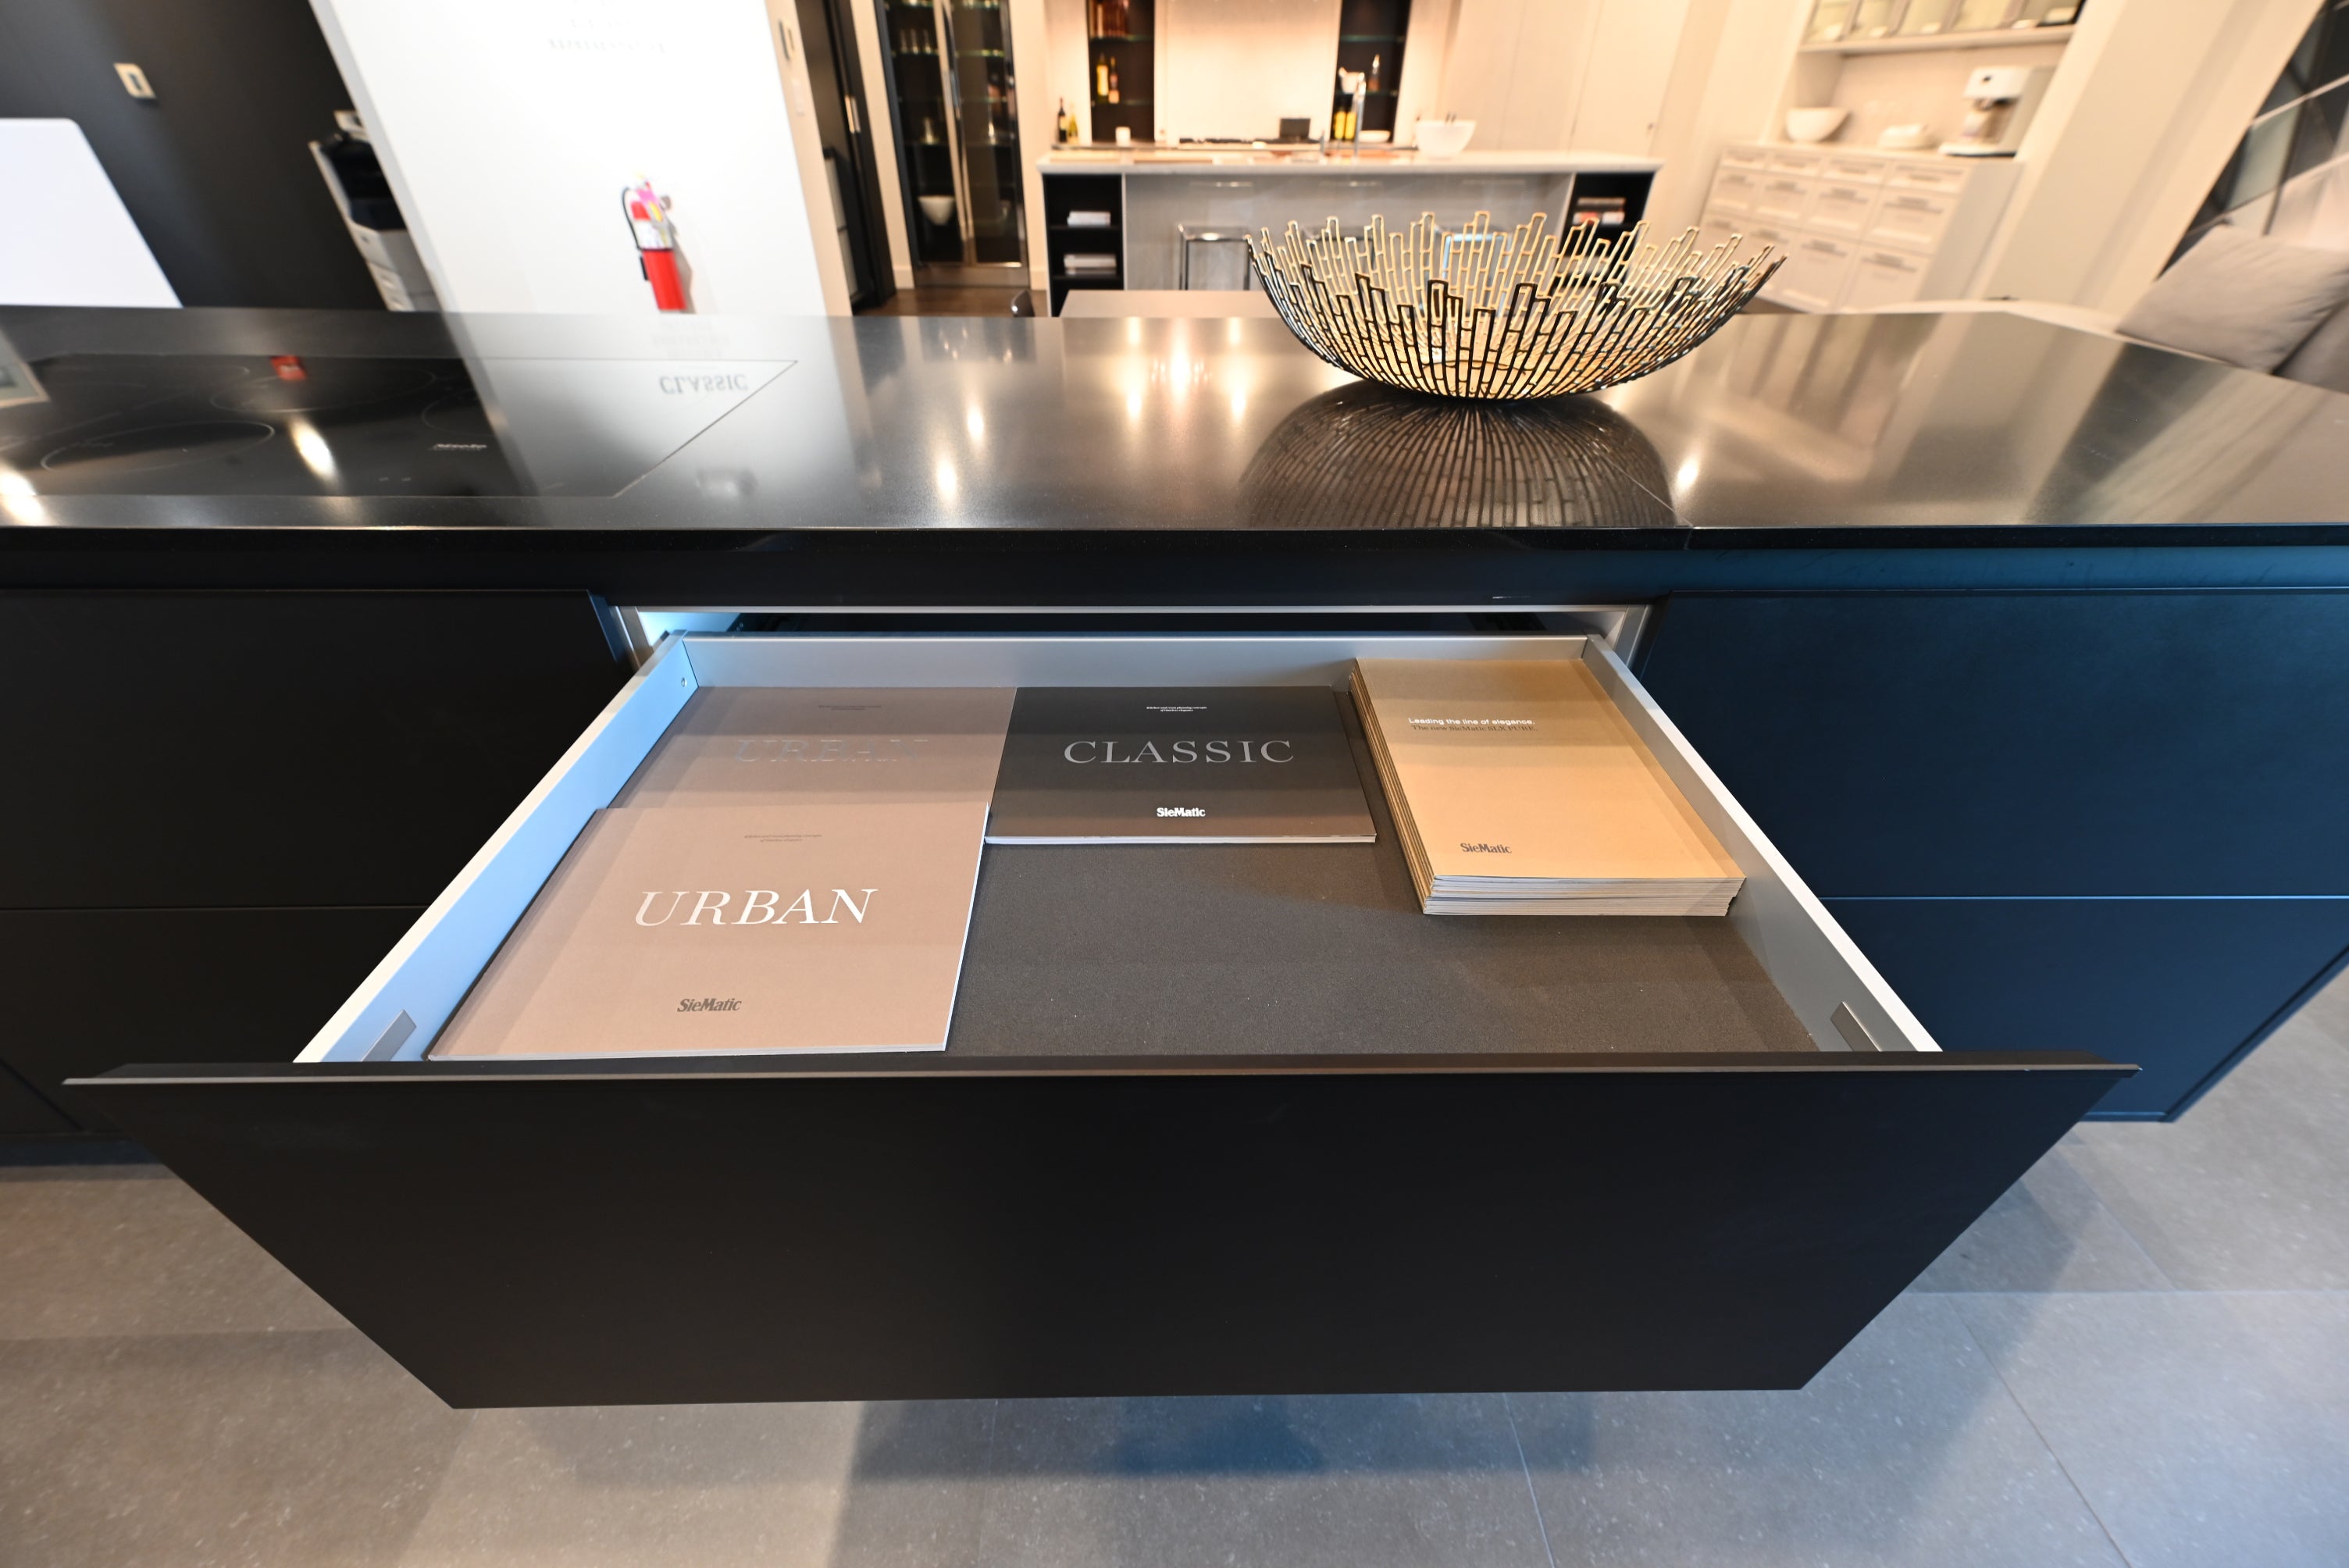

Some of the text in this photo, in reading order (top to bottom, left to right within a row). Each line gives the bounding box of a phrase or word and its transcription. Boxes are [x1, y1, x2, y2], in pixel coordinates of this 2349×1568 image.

[736, 739, 929, 762] URBAN
[1064, 740, 1294, 764] CLASSIC
[1156, 807, 1207, 818] SieMatic
[1460, 843, 1513, 854] SieMatic
[635, 888, 879, 927] URBAN
[676, 997, 743, 1013] SieMatic
